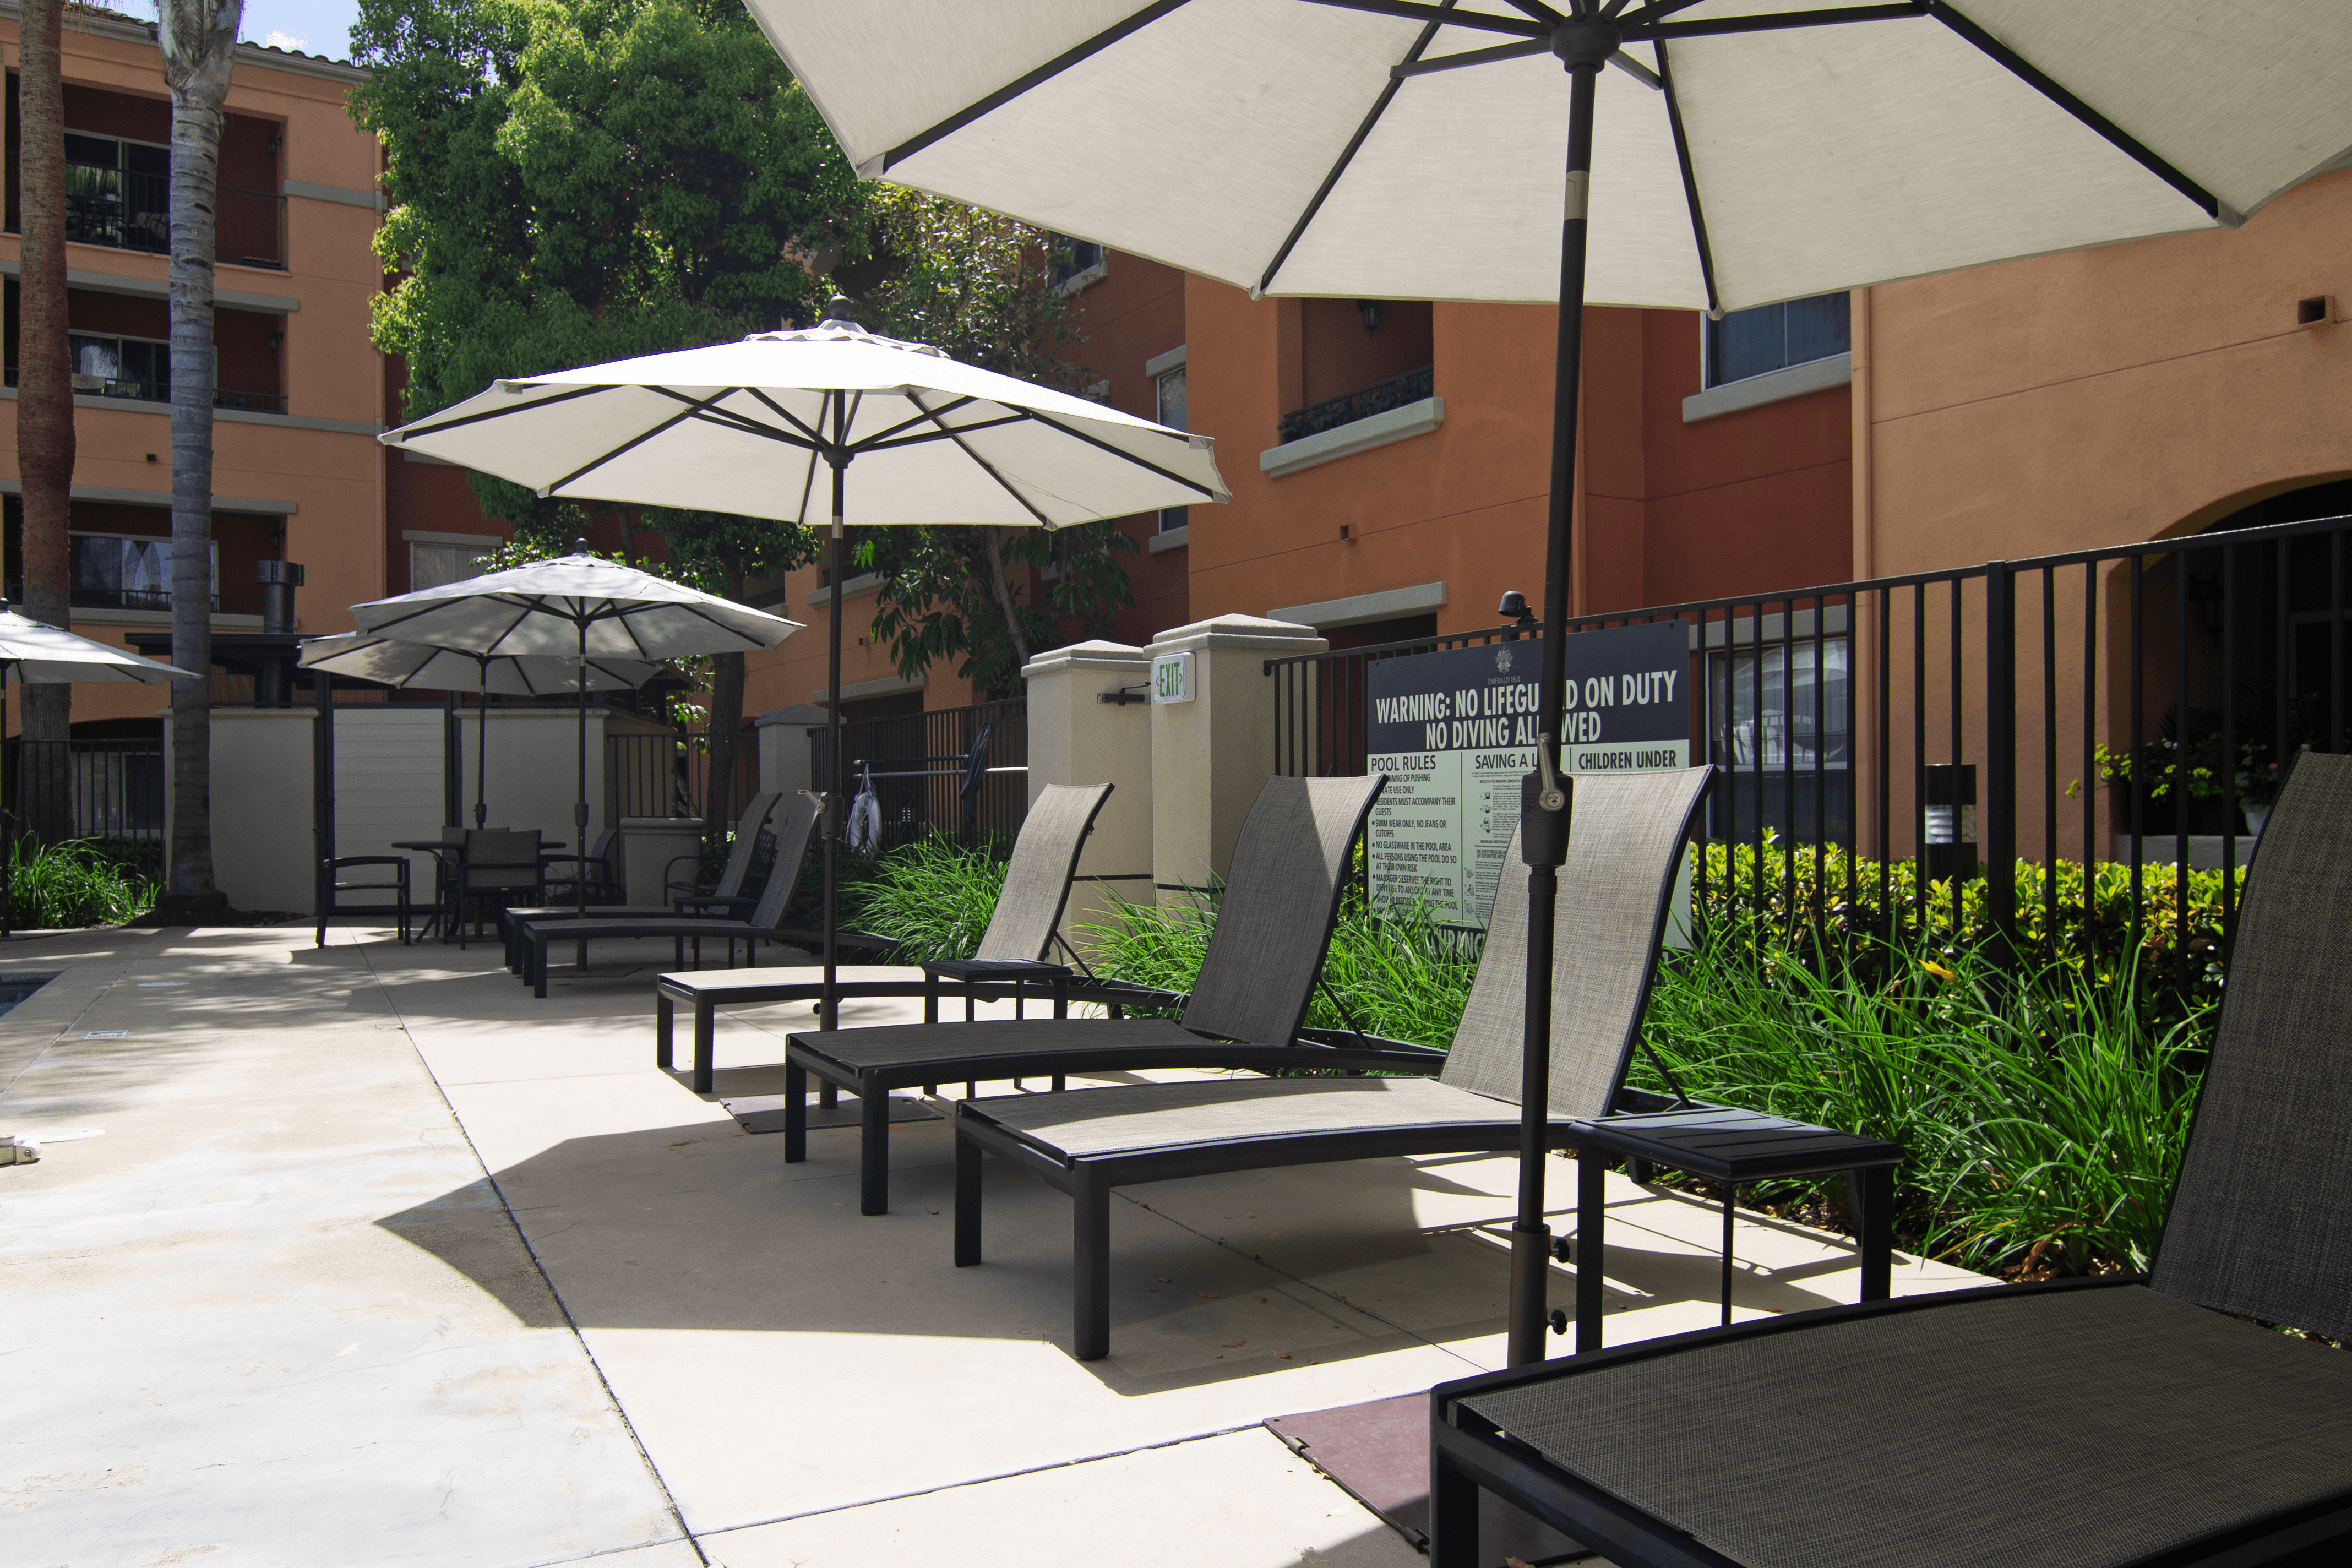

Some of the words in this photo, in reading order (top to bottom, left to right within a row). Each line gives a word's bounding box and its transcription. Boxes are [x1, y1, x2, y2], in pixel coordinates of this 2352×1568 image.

[1159, 662, 1179, 697] EXIT
[1488, 677, 1510, 685] EMERALD
[1376, 692, 1450, 723] WARNING:
[1456, 689, 1478, 717] NO
[1484, 680, 1578, 715] LIFEGUD
[1585, 676, 1614, 708] ON
[1623, 670, 1677, 705] DUTY
[1426, 722, 1447, 749] NO
[1453, 717, 1509, 748] DIVING
[1515, 712, 1601, 745] ALWED
[1371, 756, 1399, 771] POOL
[1403, 755, 1436, 770] RULES
[1476, 754, 1516, 769] SAVING
[1519, 753, 1528, 767] A
[1578, 752, 1632, 770] CHILDREN
[1636, 750, 1676, 768] UNDER
[1411, 774, 1430, 782] PUSHING
[1402, 786, 1415, 794] ONLY
[1442, 797, 1456, 805] THEIR
[1402, 819, 1415, 828] ONLY,
[1424, 820, 1438, 828] JEANS
[1439, 820, 1446, 828] OR
[1375, 829, 1394, 837] CUTOFFS
[1383, 841, 1409, 850] GLASSWARE
[1416, 842, 1424, 850] THE
[1425, 842, 1438, 851] POOL
[1384, 852, 1403, 861] PERSONS
[1404, 853, 1418, 862] USING
[1419, 854, 1428, 862] THE
[1428, 854, 1441, 863] POOL
[1442, 855, 1449, 863] DO
[1450, 855, 1457, 863] SO
[1382, 862, 1395, 870] THEIR
[1395, 863, 1407, 872] OWN
[1407, 864, 1418, 872] RISK
[1420, 876, 1429, 885] THE
[1430, 877, 1444, 886] RIGHT
[1445, 878, 1451, 886] TO
[1431, 888, 1442, 896] ANY
[1443, 889, 1455, 897] TIME
